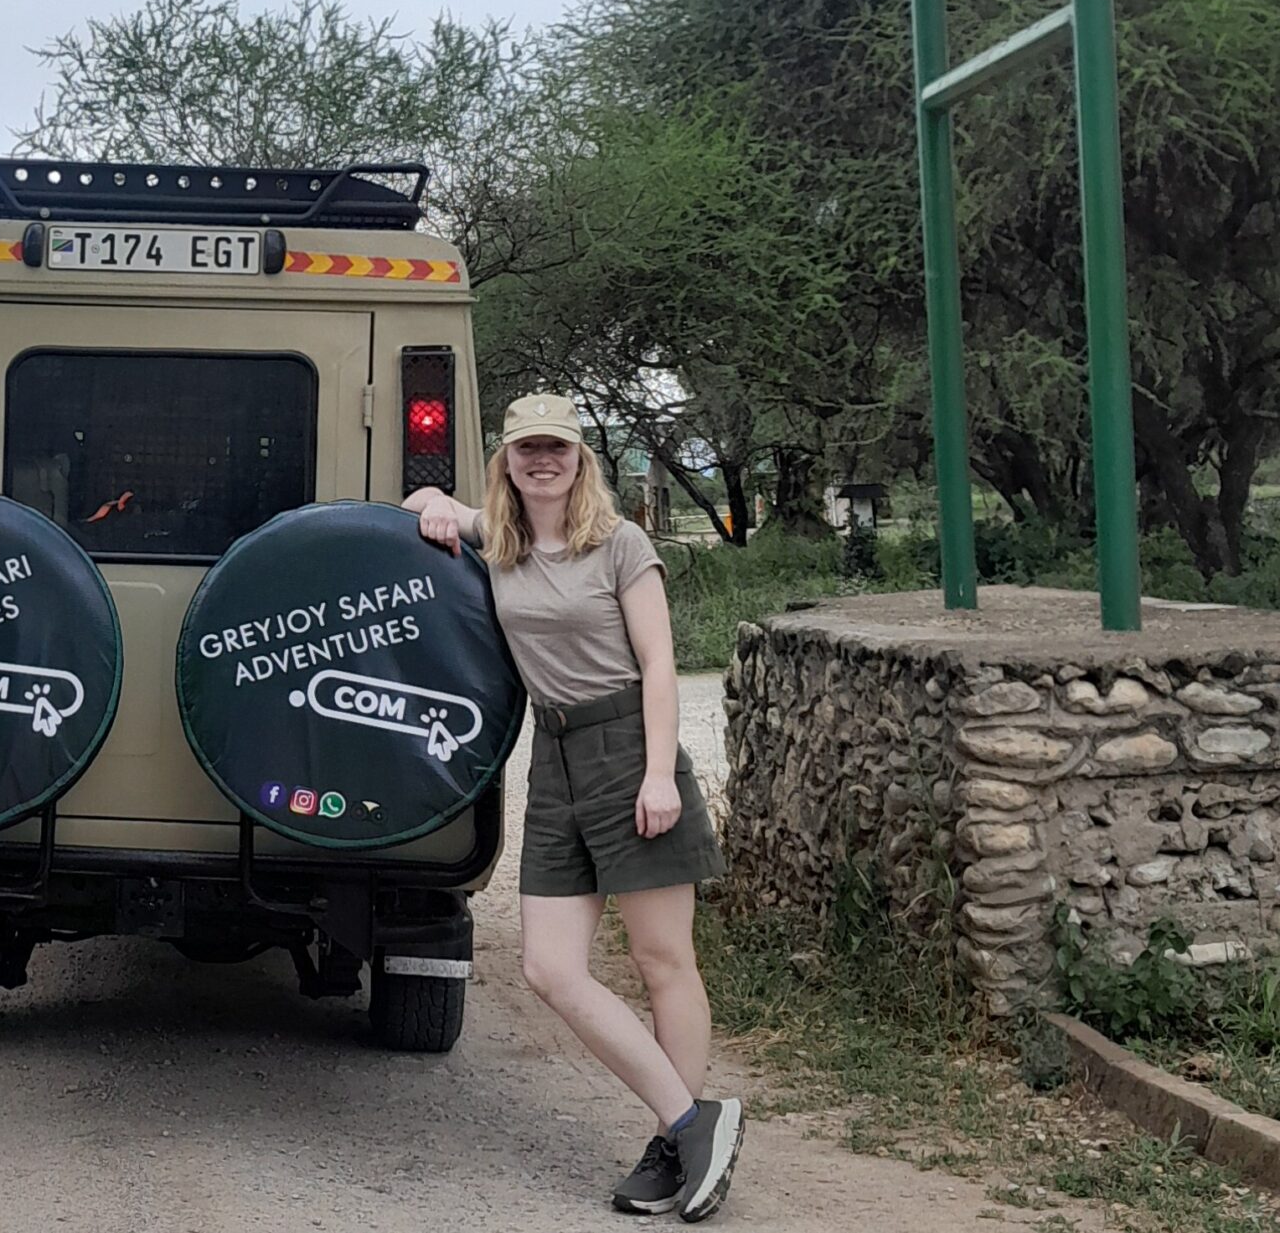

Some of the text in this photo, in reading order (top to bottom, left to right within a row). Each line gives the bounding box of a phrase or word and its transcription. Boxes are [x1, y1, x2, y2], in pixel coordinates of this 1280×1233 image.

[190, 235, 255, 269] EGT
[199, 575, 436, 659] GREYJOY SAFARI
[235, 615, 421, 687] ADVENTURES
